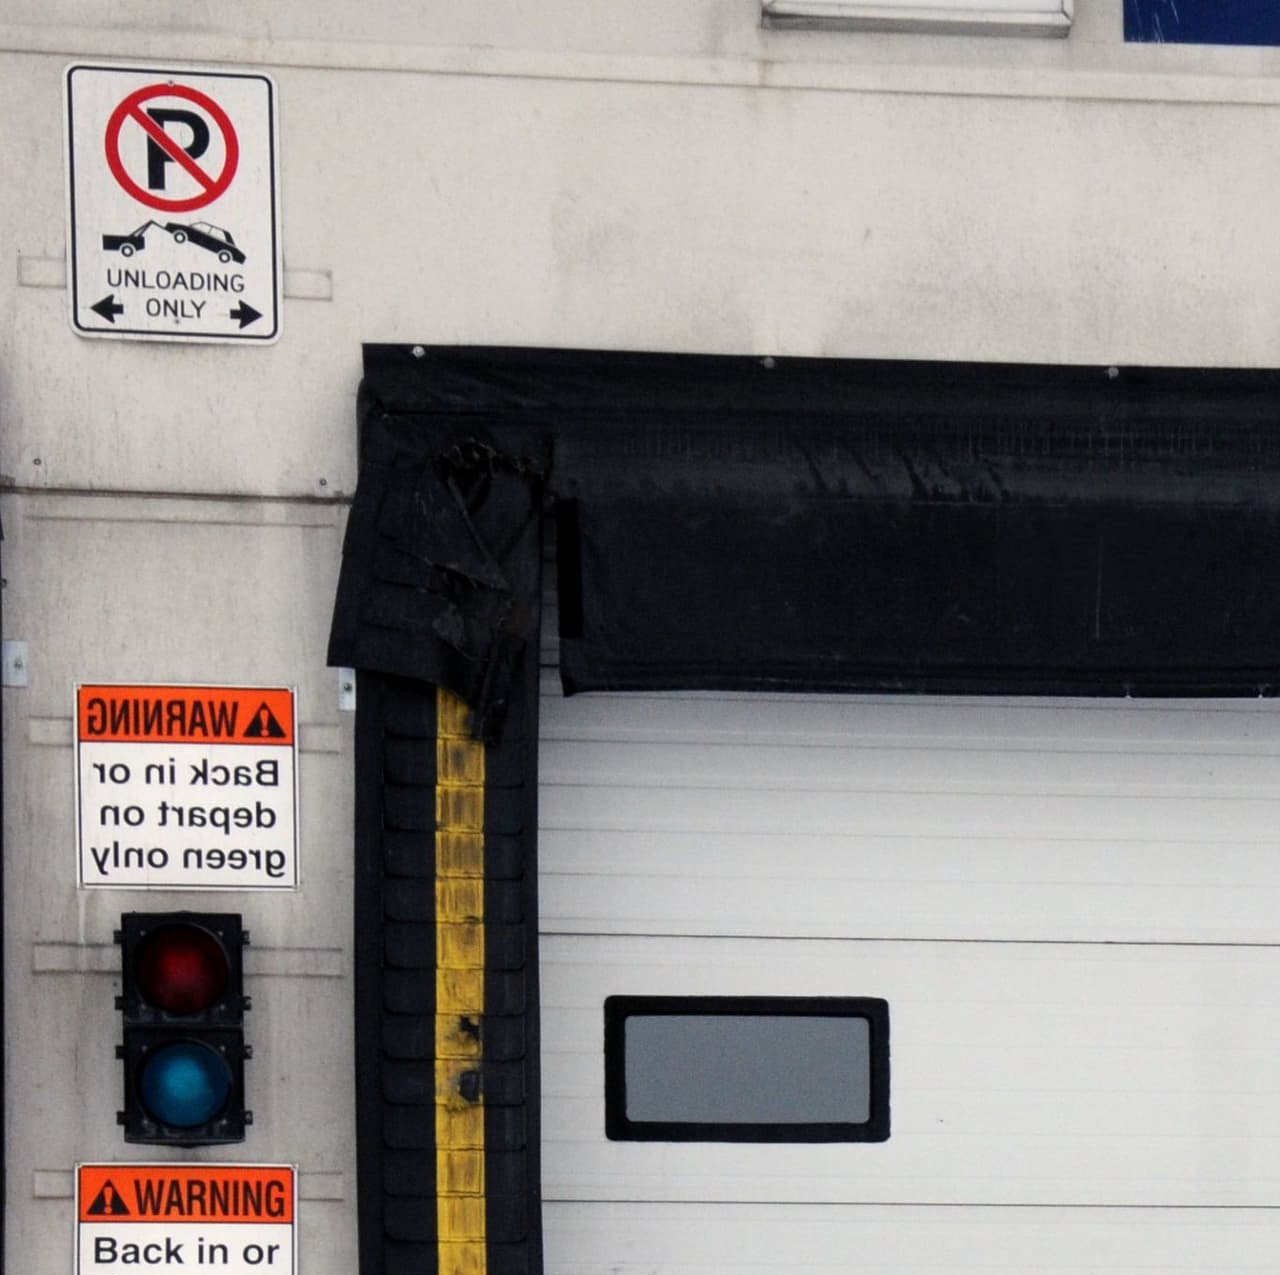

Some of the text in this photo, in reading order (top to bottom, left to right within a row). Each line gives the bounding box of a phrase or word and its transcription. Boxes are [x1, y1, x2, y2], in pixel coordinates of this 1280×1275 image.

[106, 268, 245, 293] UNLOADING
[145, 297, 206, 319] ONLY
[133, 1179, 285, 1218] WARNING
[94, 1236, 280, 1265] Back in or
